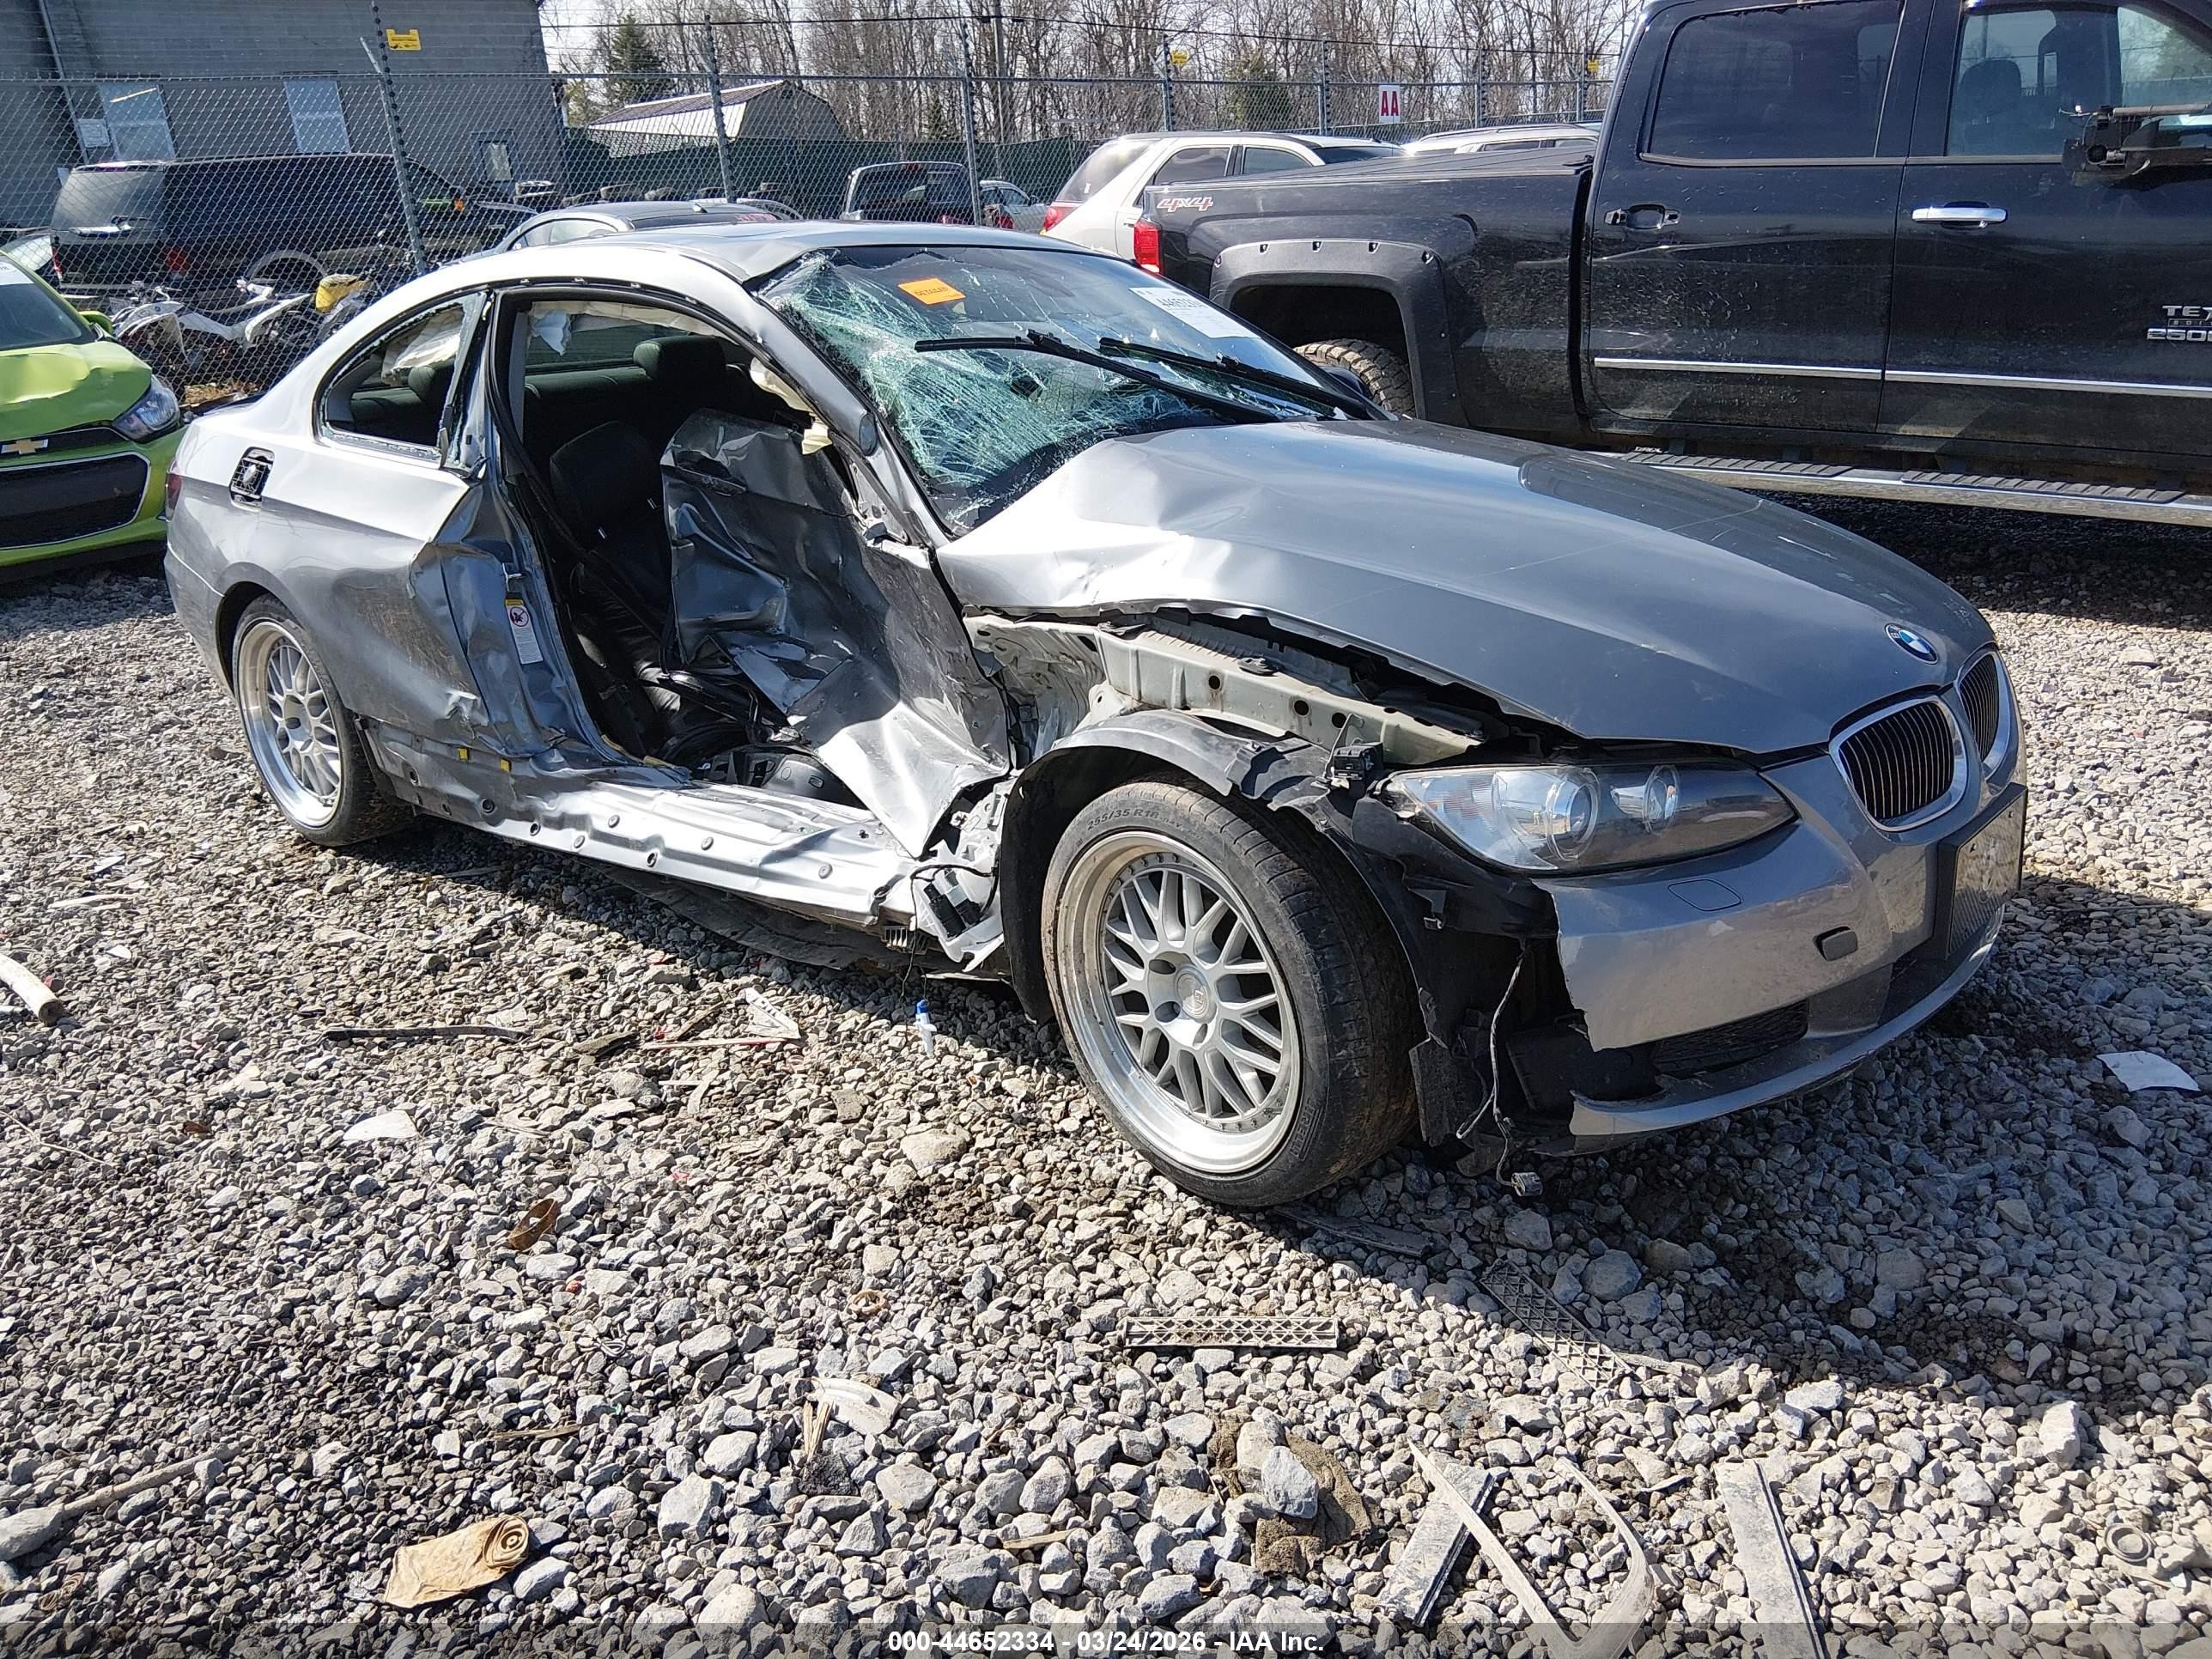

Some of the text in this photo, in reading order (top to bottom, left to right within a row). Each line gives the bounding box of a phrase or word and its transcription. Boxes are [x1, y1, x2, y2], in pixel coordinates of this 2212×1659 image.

[1381, 90, 1400, 117] AA
[2147, 328, 2212, 342] 250
[1087, 808, 1131, 831] 255/35
